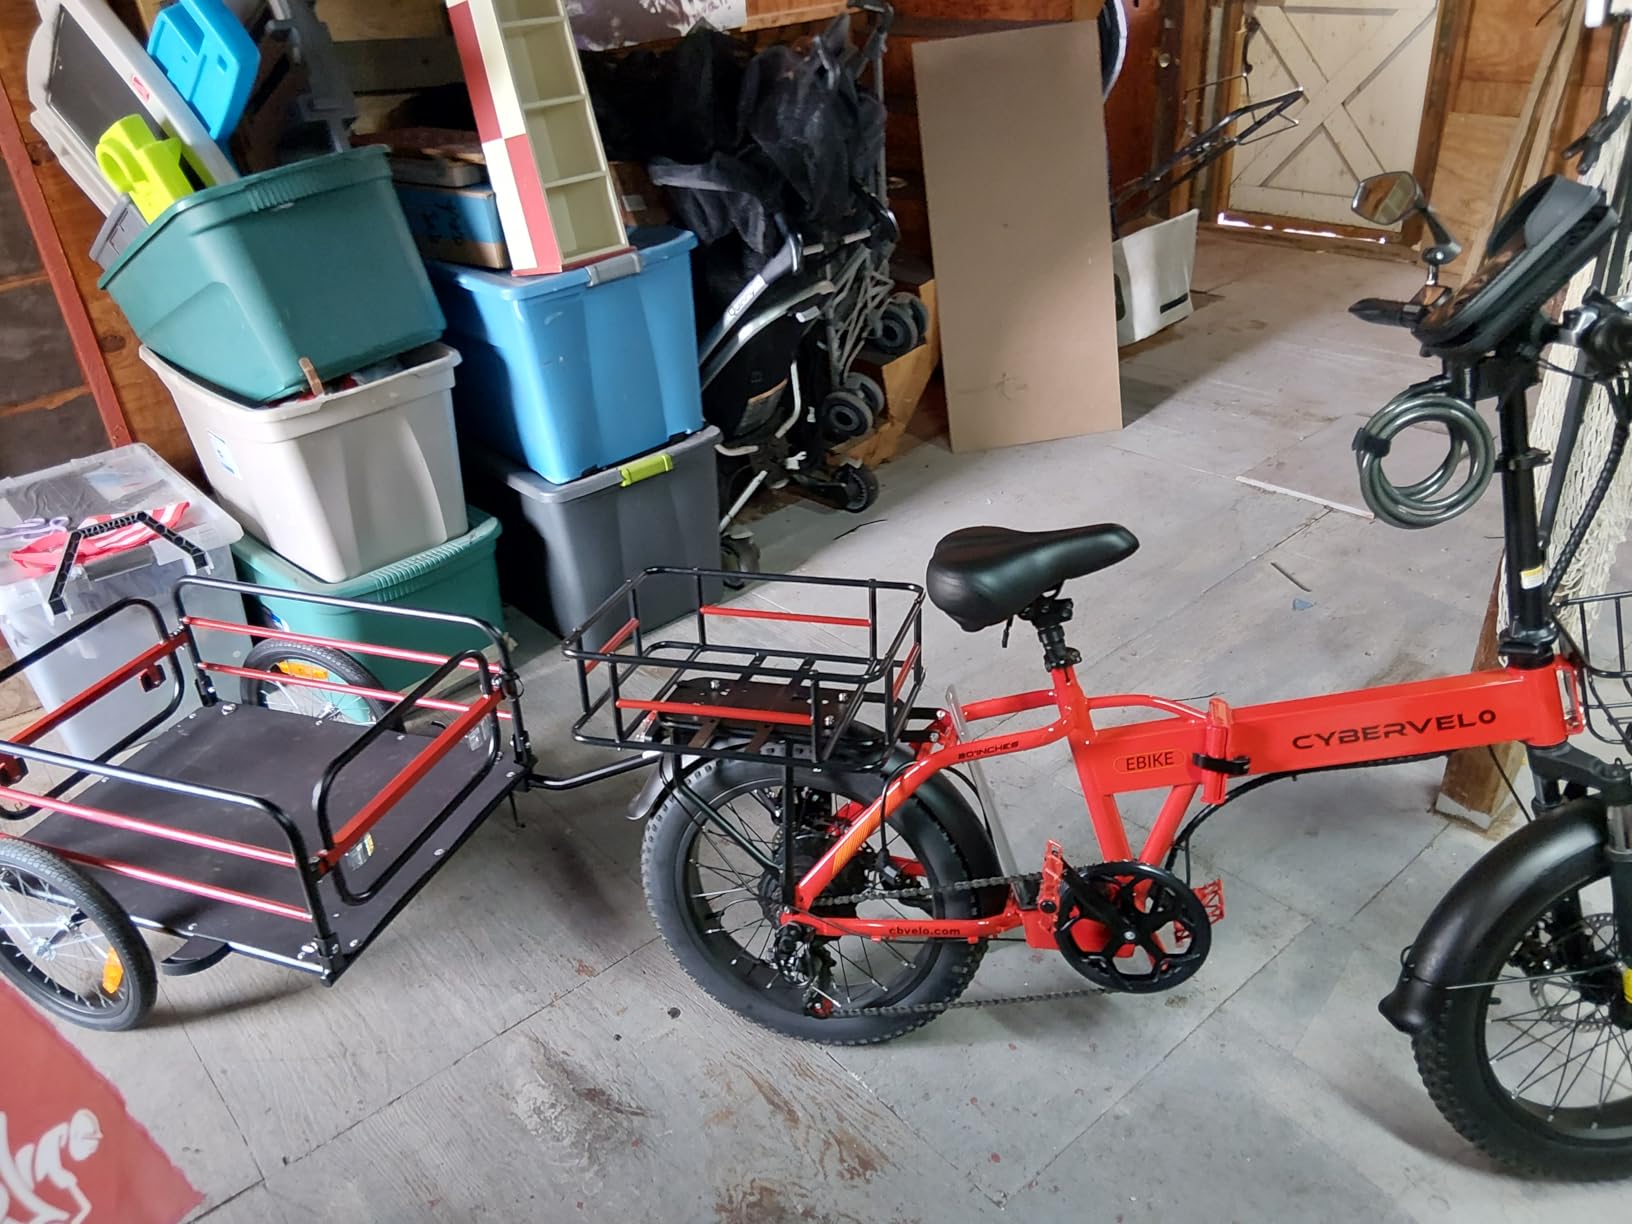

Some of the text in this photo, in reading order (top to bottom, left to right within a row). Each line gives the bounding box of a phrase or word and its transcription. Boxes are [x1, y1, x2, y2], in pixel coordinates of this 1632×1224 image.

[1292, 709, 1496, 749] CYBERVELO
[1126, 751, 1174, 771] EBIKE
[889, 925, 961, 935] cbvelo.com
